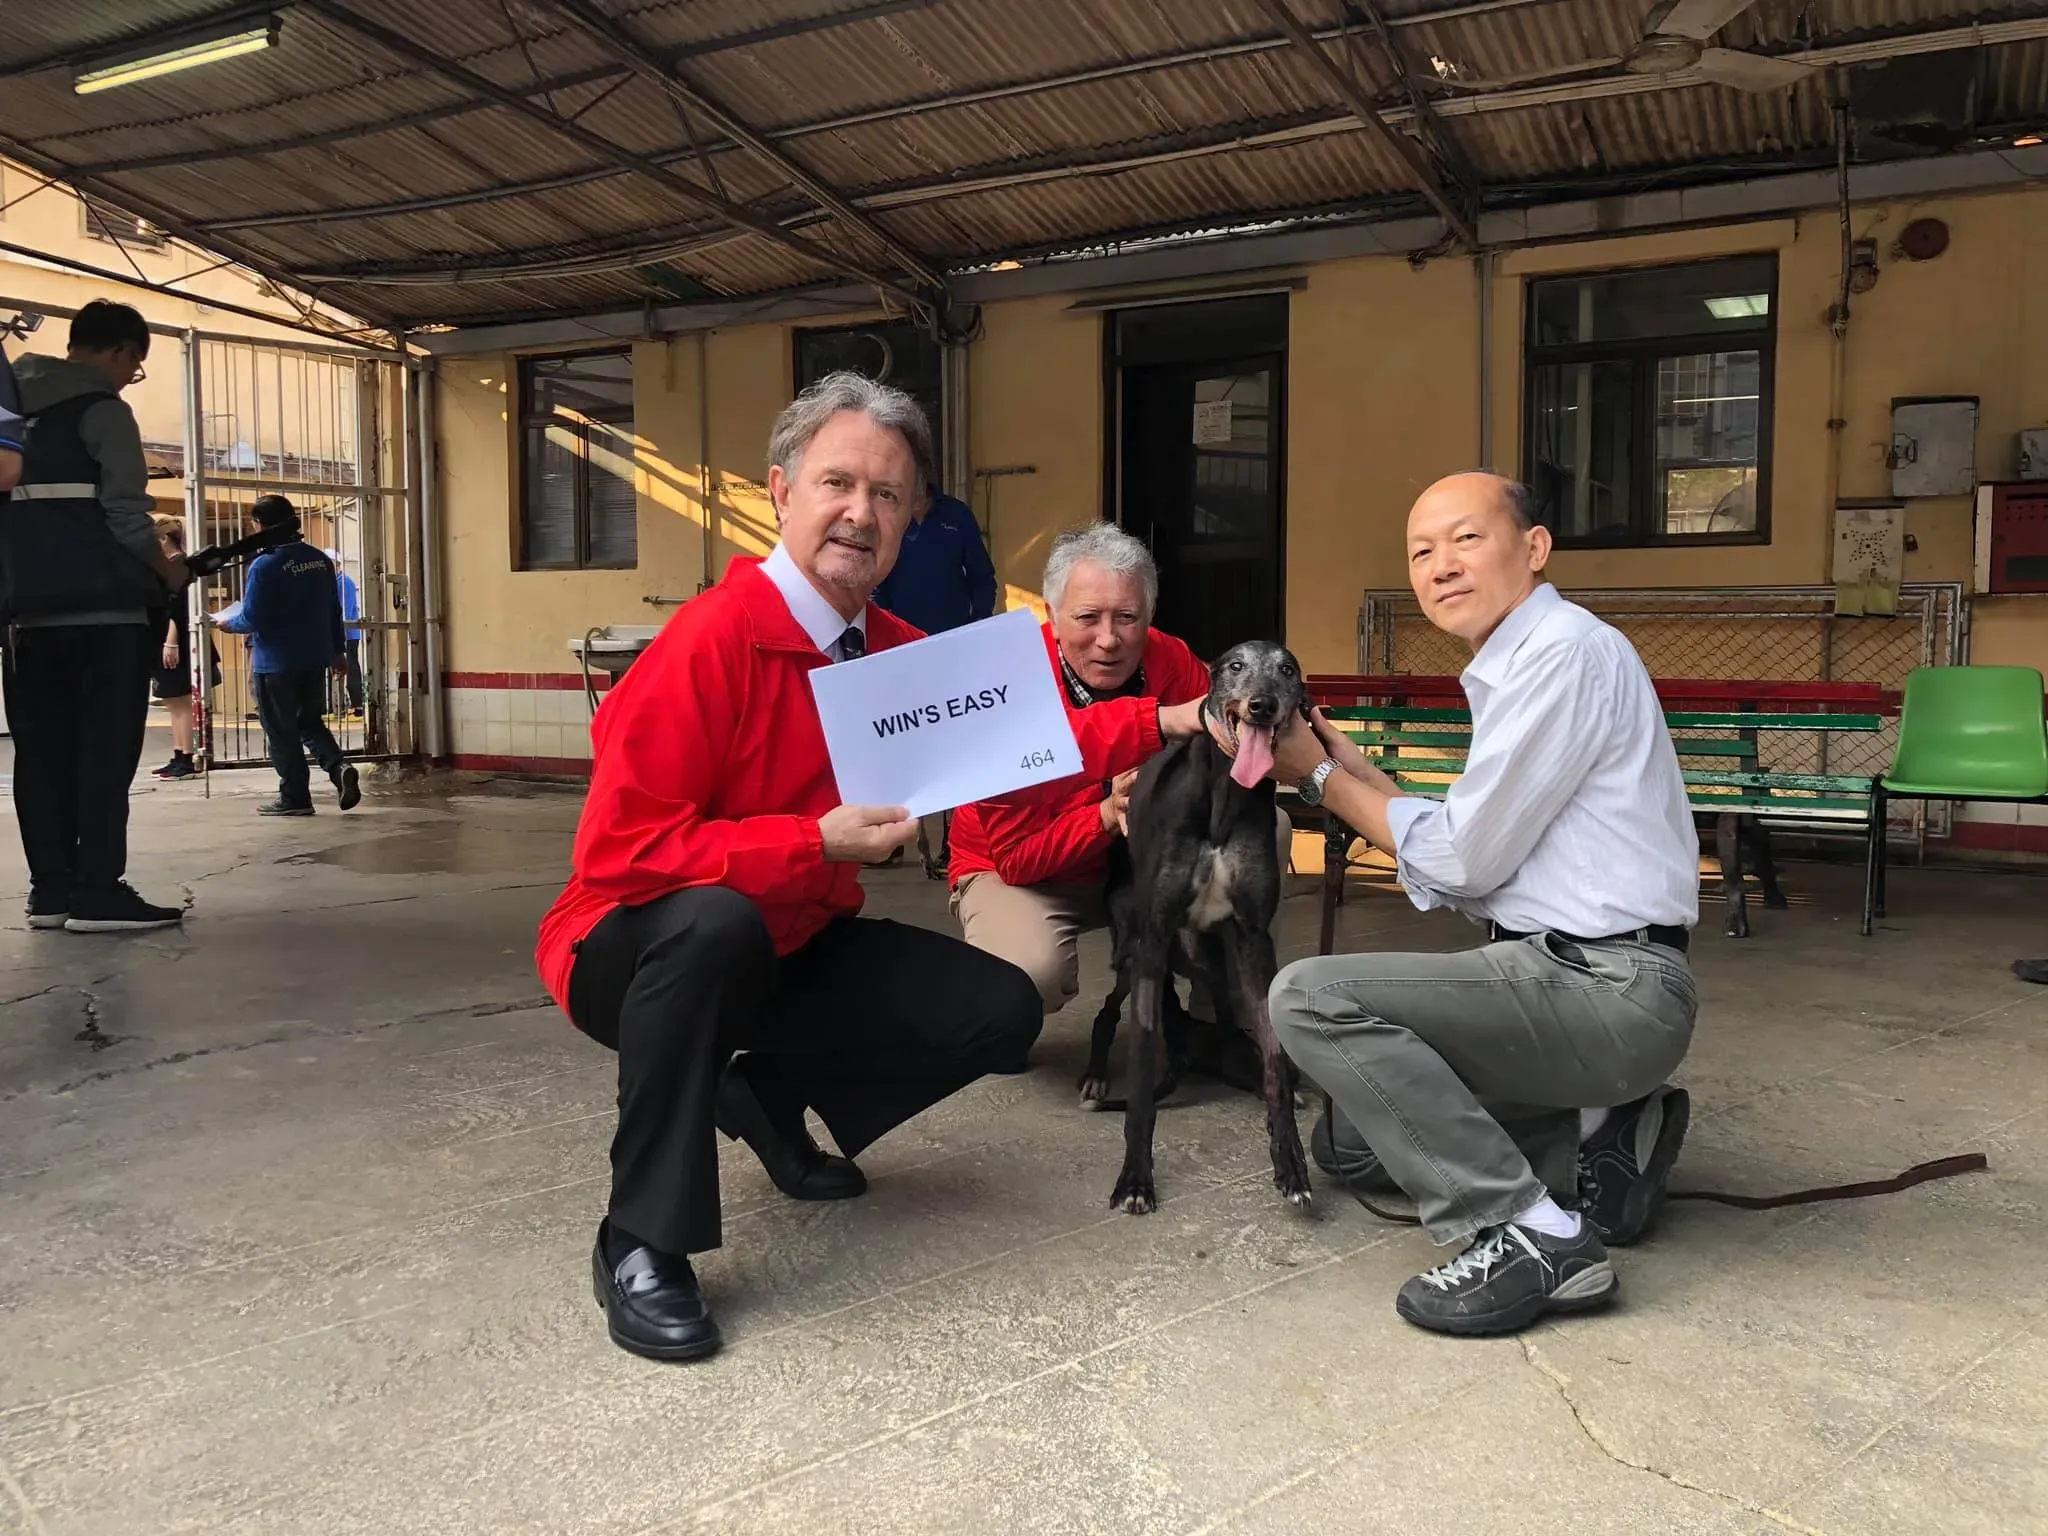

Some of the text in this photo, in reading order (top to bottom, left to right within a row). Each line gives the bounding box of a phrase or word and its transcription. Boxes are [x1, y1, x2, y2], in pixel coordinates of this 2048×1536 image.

[873, 685, 1008, 738] WIN'S EASY
[1020, 749, 1055, 770] 464
